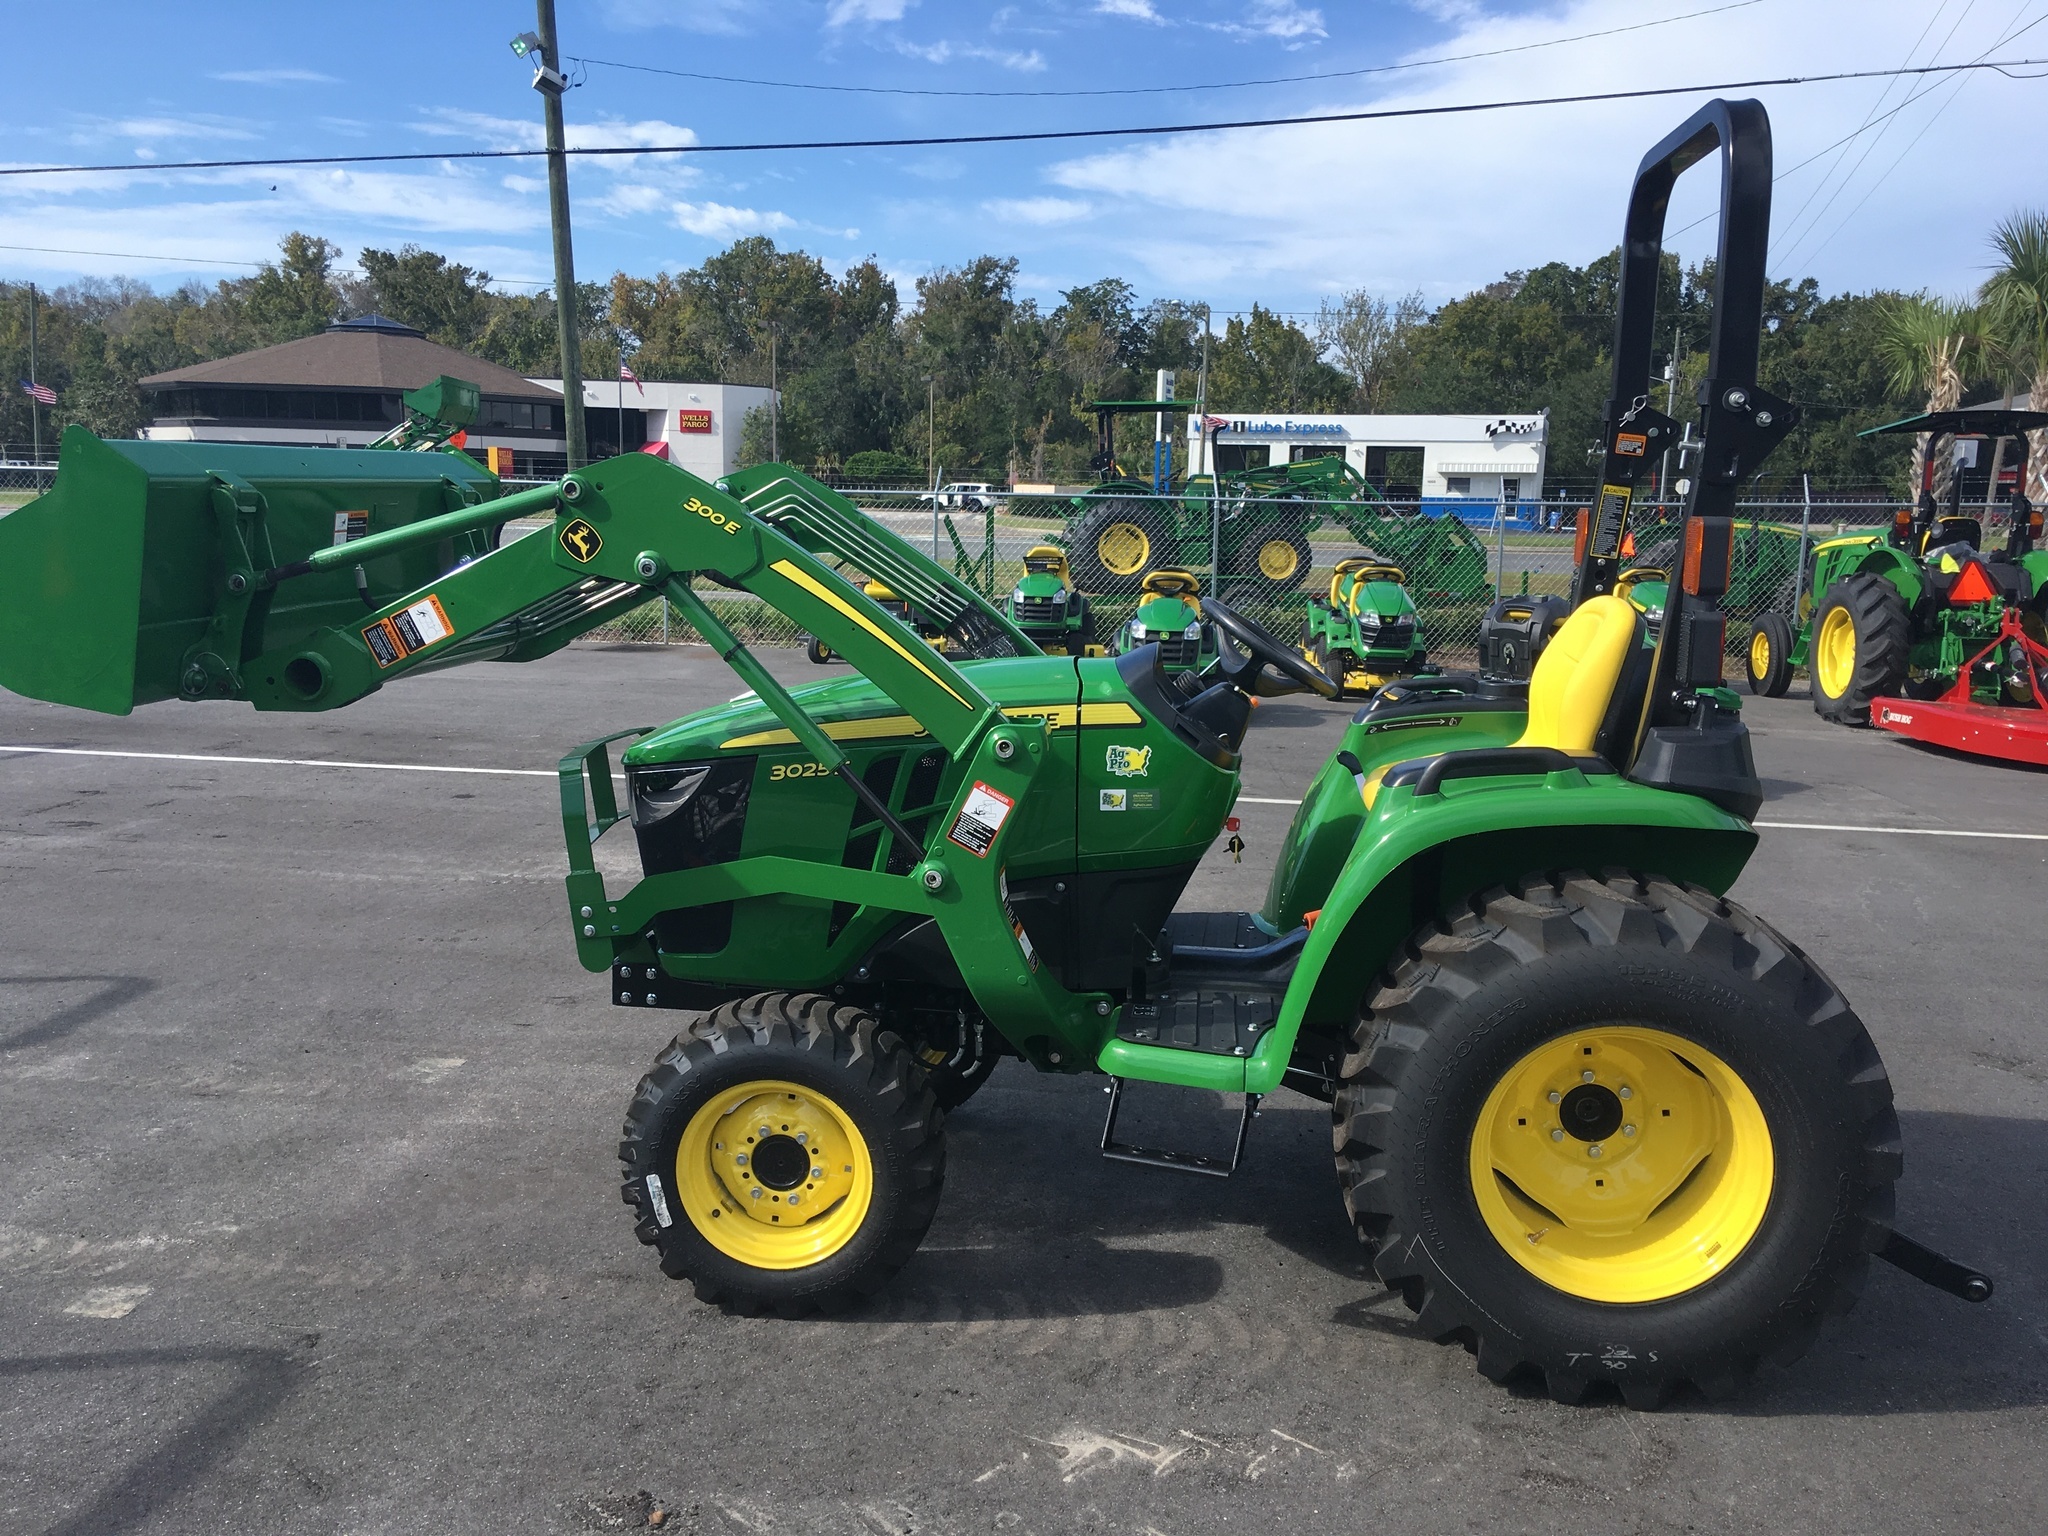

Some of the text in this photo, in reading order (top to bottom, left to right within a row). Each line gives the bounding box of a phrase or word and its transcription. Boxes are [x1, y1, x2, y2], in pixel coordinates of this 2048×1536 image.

[1248, 421, 1282, 433] Lube
[1285, 420, 1342, 435] Express
[1109, 748, 1129, 760] Ag-
[1110, 759, 1130, 769] Pro
[986, 788, 1010, 804] DANGER
